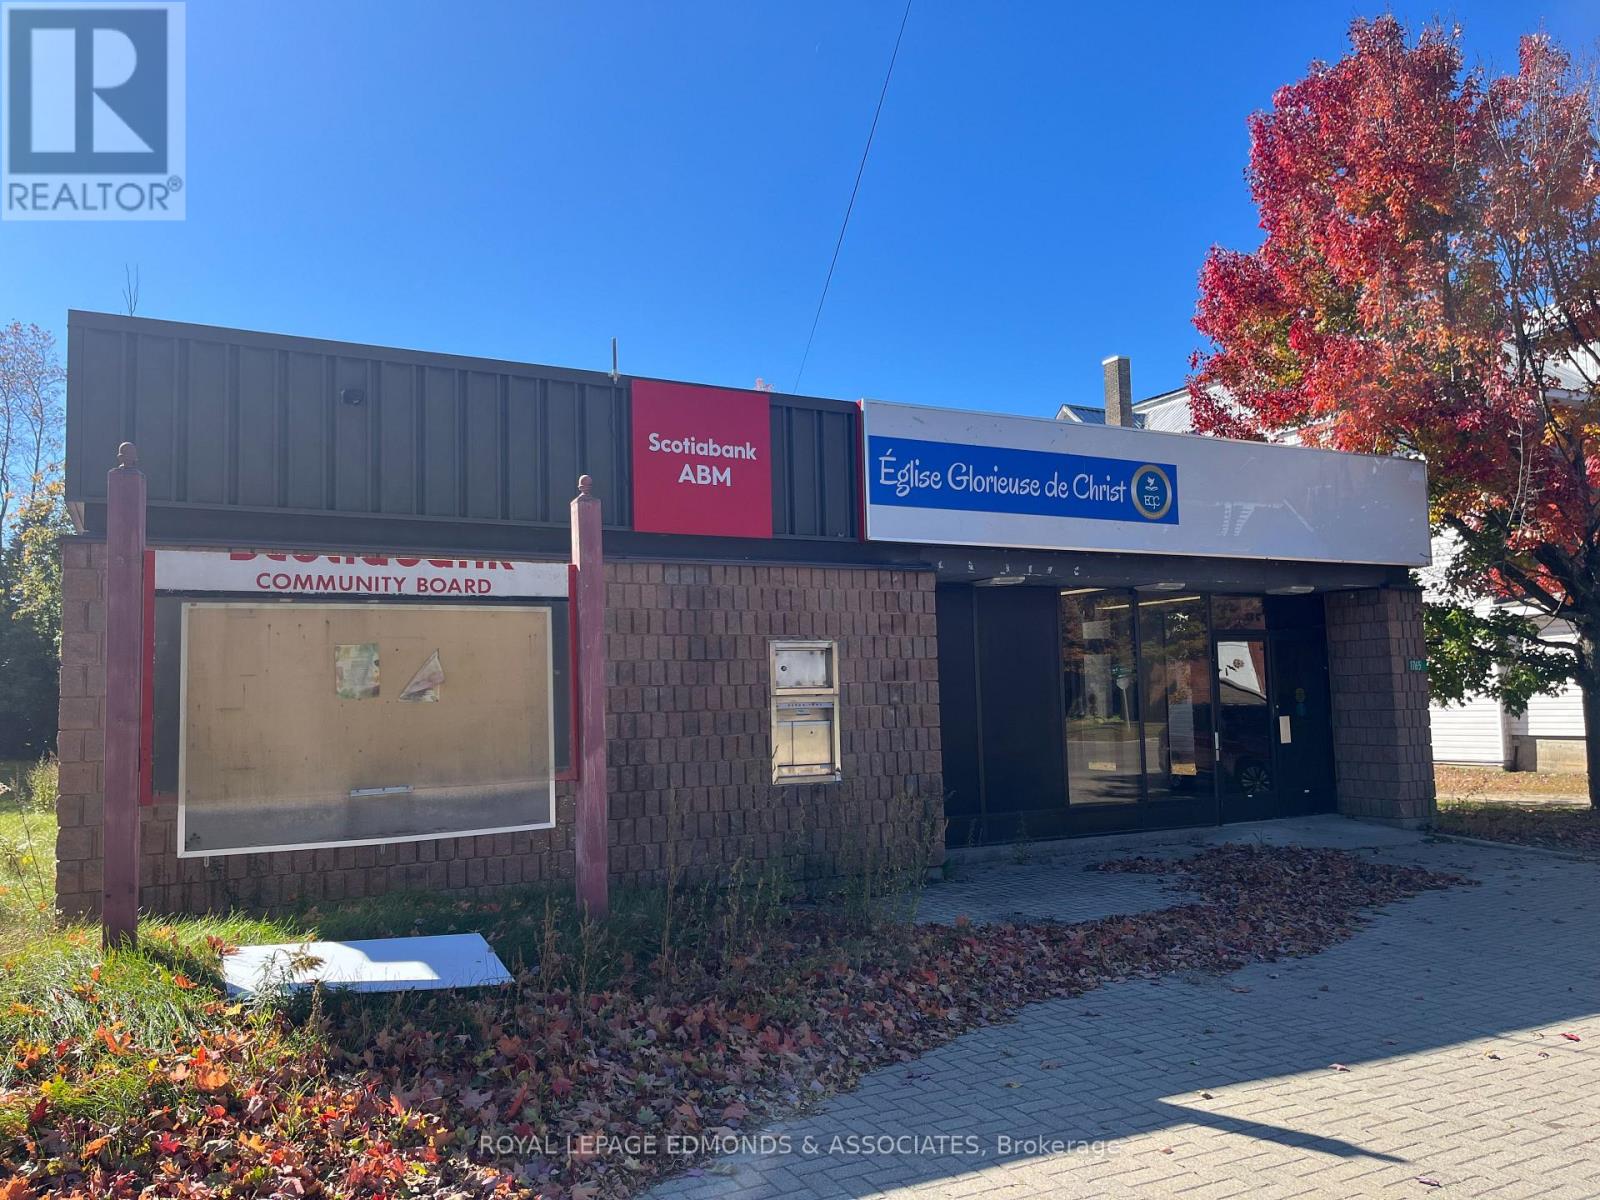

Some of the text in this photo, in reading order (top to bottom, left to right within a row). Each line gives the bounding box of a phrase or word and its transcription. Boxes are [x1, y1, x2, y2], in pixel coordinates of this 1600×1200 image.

[648, 432, 757, 460] Scotiabank
[678, 463, 732, 487] ABM
[878, 448, 1127, 503] Église Glorieuse de Christ
[256, 572, 492, 594] COMMUNITY BOARD
